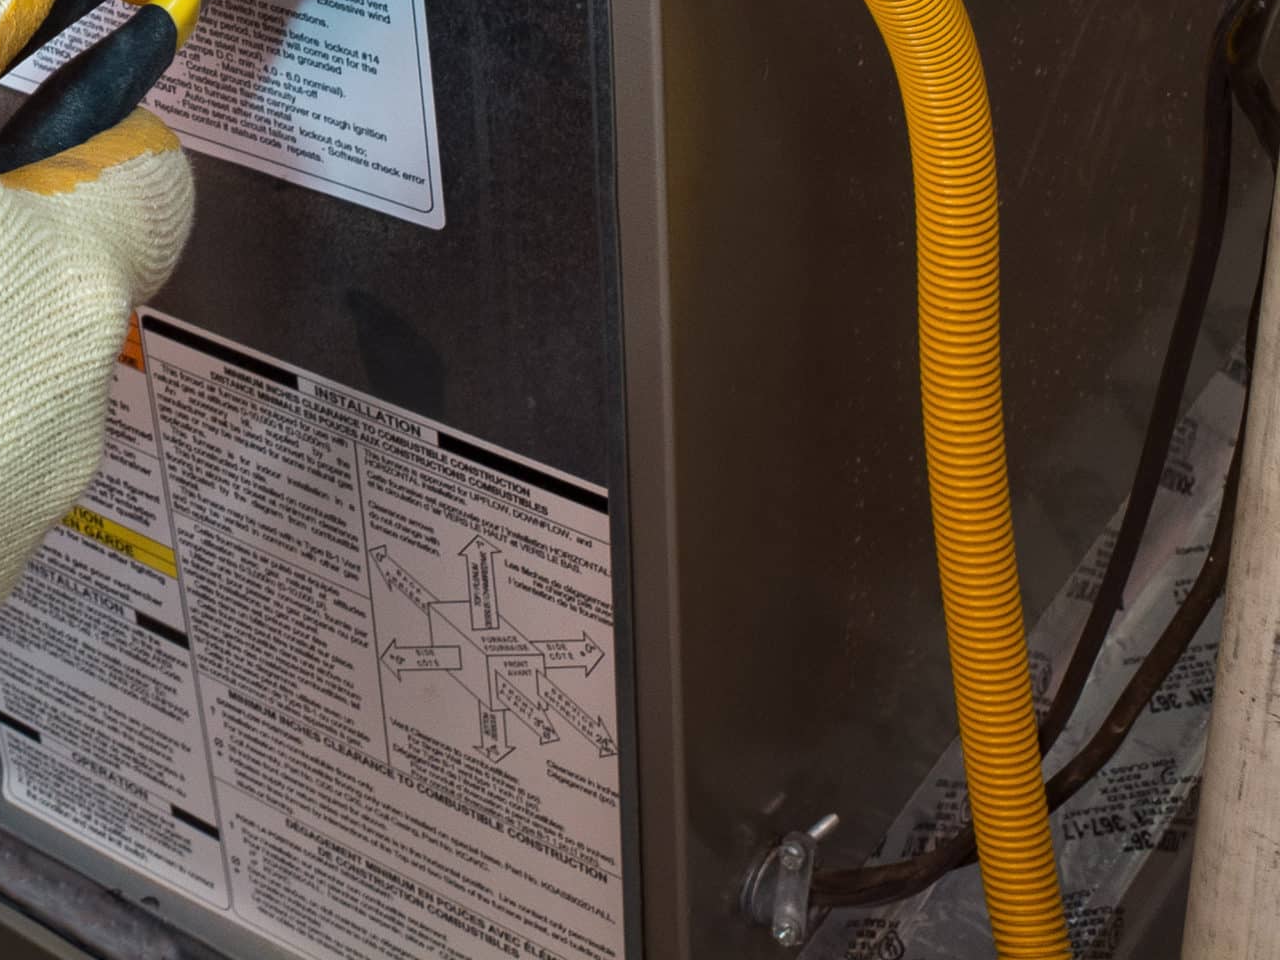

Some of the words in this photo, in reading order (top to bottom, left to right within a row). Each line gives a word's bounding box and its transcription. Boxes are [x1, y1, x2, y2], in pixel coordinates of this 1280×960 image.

[236, 15, 260, 29] more
[262, 21, 287, 37] times
[289, 29, 320, 47] before
[324, 39, 359, 59] lockout
[361, 50, 380, 65] #14
[270, 2, 328, 28] connections.
[367, 9, 390, 25] wind
[186, 60, 218, 79] Control
[219, 70, 251, 90] ground
[252, 81, 296, 104] continuity
[221, 61, 255, 80] Manual
[257, 72, 282, 88] valve
[282, 79, 318, 99] shut-off
[241, 37, 264, 52] must
[265, 44, 281, 57] not
[283, 49, 295, 61] be
[297, 53, 342, 77] grounded
[262, 63, 278, 76] 4.0
[285, 71, 300, 83] 6.0
[286, 39, 301, 52] will
[303, 46, 329, 60] come
[331, 54, 344, 65] on
[345, 57, 359, 69] for
[361, 61, 377, 75] the
[154, 99, 190, 120] Replace
[191, 112, 221, 129] control
[230, 125, 257, 141] status
[259, 134, 281, 148] code
[184, 90, 230, 112] Auto-reset
[231, 105, 252, 119] after
[254, 113, 271, 125] one
[273, 118, 294, 132] hour
[298, 126, 333, 146] lockout
[334, 138, 352, 152] due
[188, 71, 237, 96] Inadequate
[239, 87, 262, 102] flame
[266, 96, 310, 119] carryover
[311, 110, 321, 121] or
[323, 113, 351, 133] rough
[352, 121, 387, 144] ignition
[204, 86, 237, 104] furnace
[239, 98, 264, 113] sheet
[266, 106, 291, 122] metal
[181, 98, 209, 115] Flame
[211, 110, 237, 124] sense
[239, 118, 266, 134] circuit
[268, 127, 296, 143] failure
[327, 146, 369, 167] Software
[371, 160, 399, 177] check
[402, 171, 425, 186] error
[313, 383, 421, 439] INSTALLATION
[301, 396, 360, 430] CLEARANCE
[361, 421, 375, 436] TO
[376, 426, 448, 465] COMBUSTIBLE
[449, 455, 530, 499] CONSTRUCTION
[384, 439, 466, 484] CONSTRUCTIONS
[468, 474, 549, 518] COMBUSTIBLES
[278, 714, 321, 743] INCHES
[323, 736, 395, 780] CLEARANCE
[398, 772, 413, 789] TO
[416, 783, 504, 834] COMBUSTIBLE
[506, 827, 608, 885] CONSTRUCTION
[334, 854, 424, 909] CONSTRUCTION
[426, 902, 520, 960] COMBUSTIBLES
[365, 858, 415, 894] MINIMUM
[417, 886, 434, 904] EN
[435, 895, 485, 930] POUCES
[487, 922, 521, 948] AVEC
